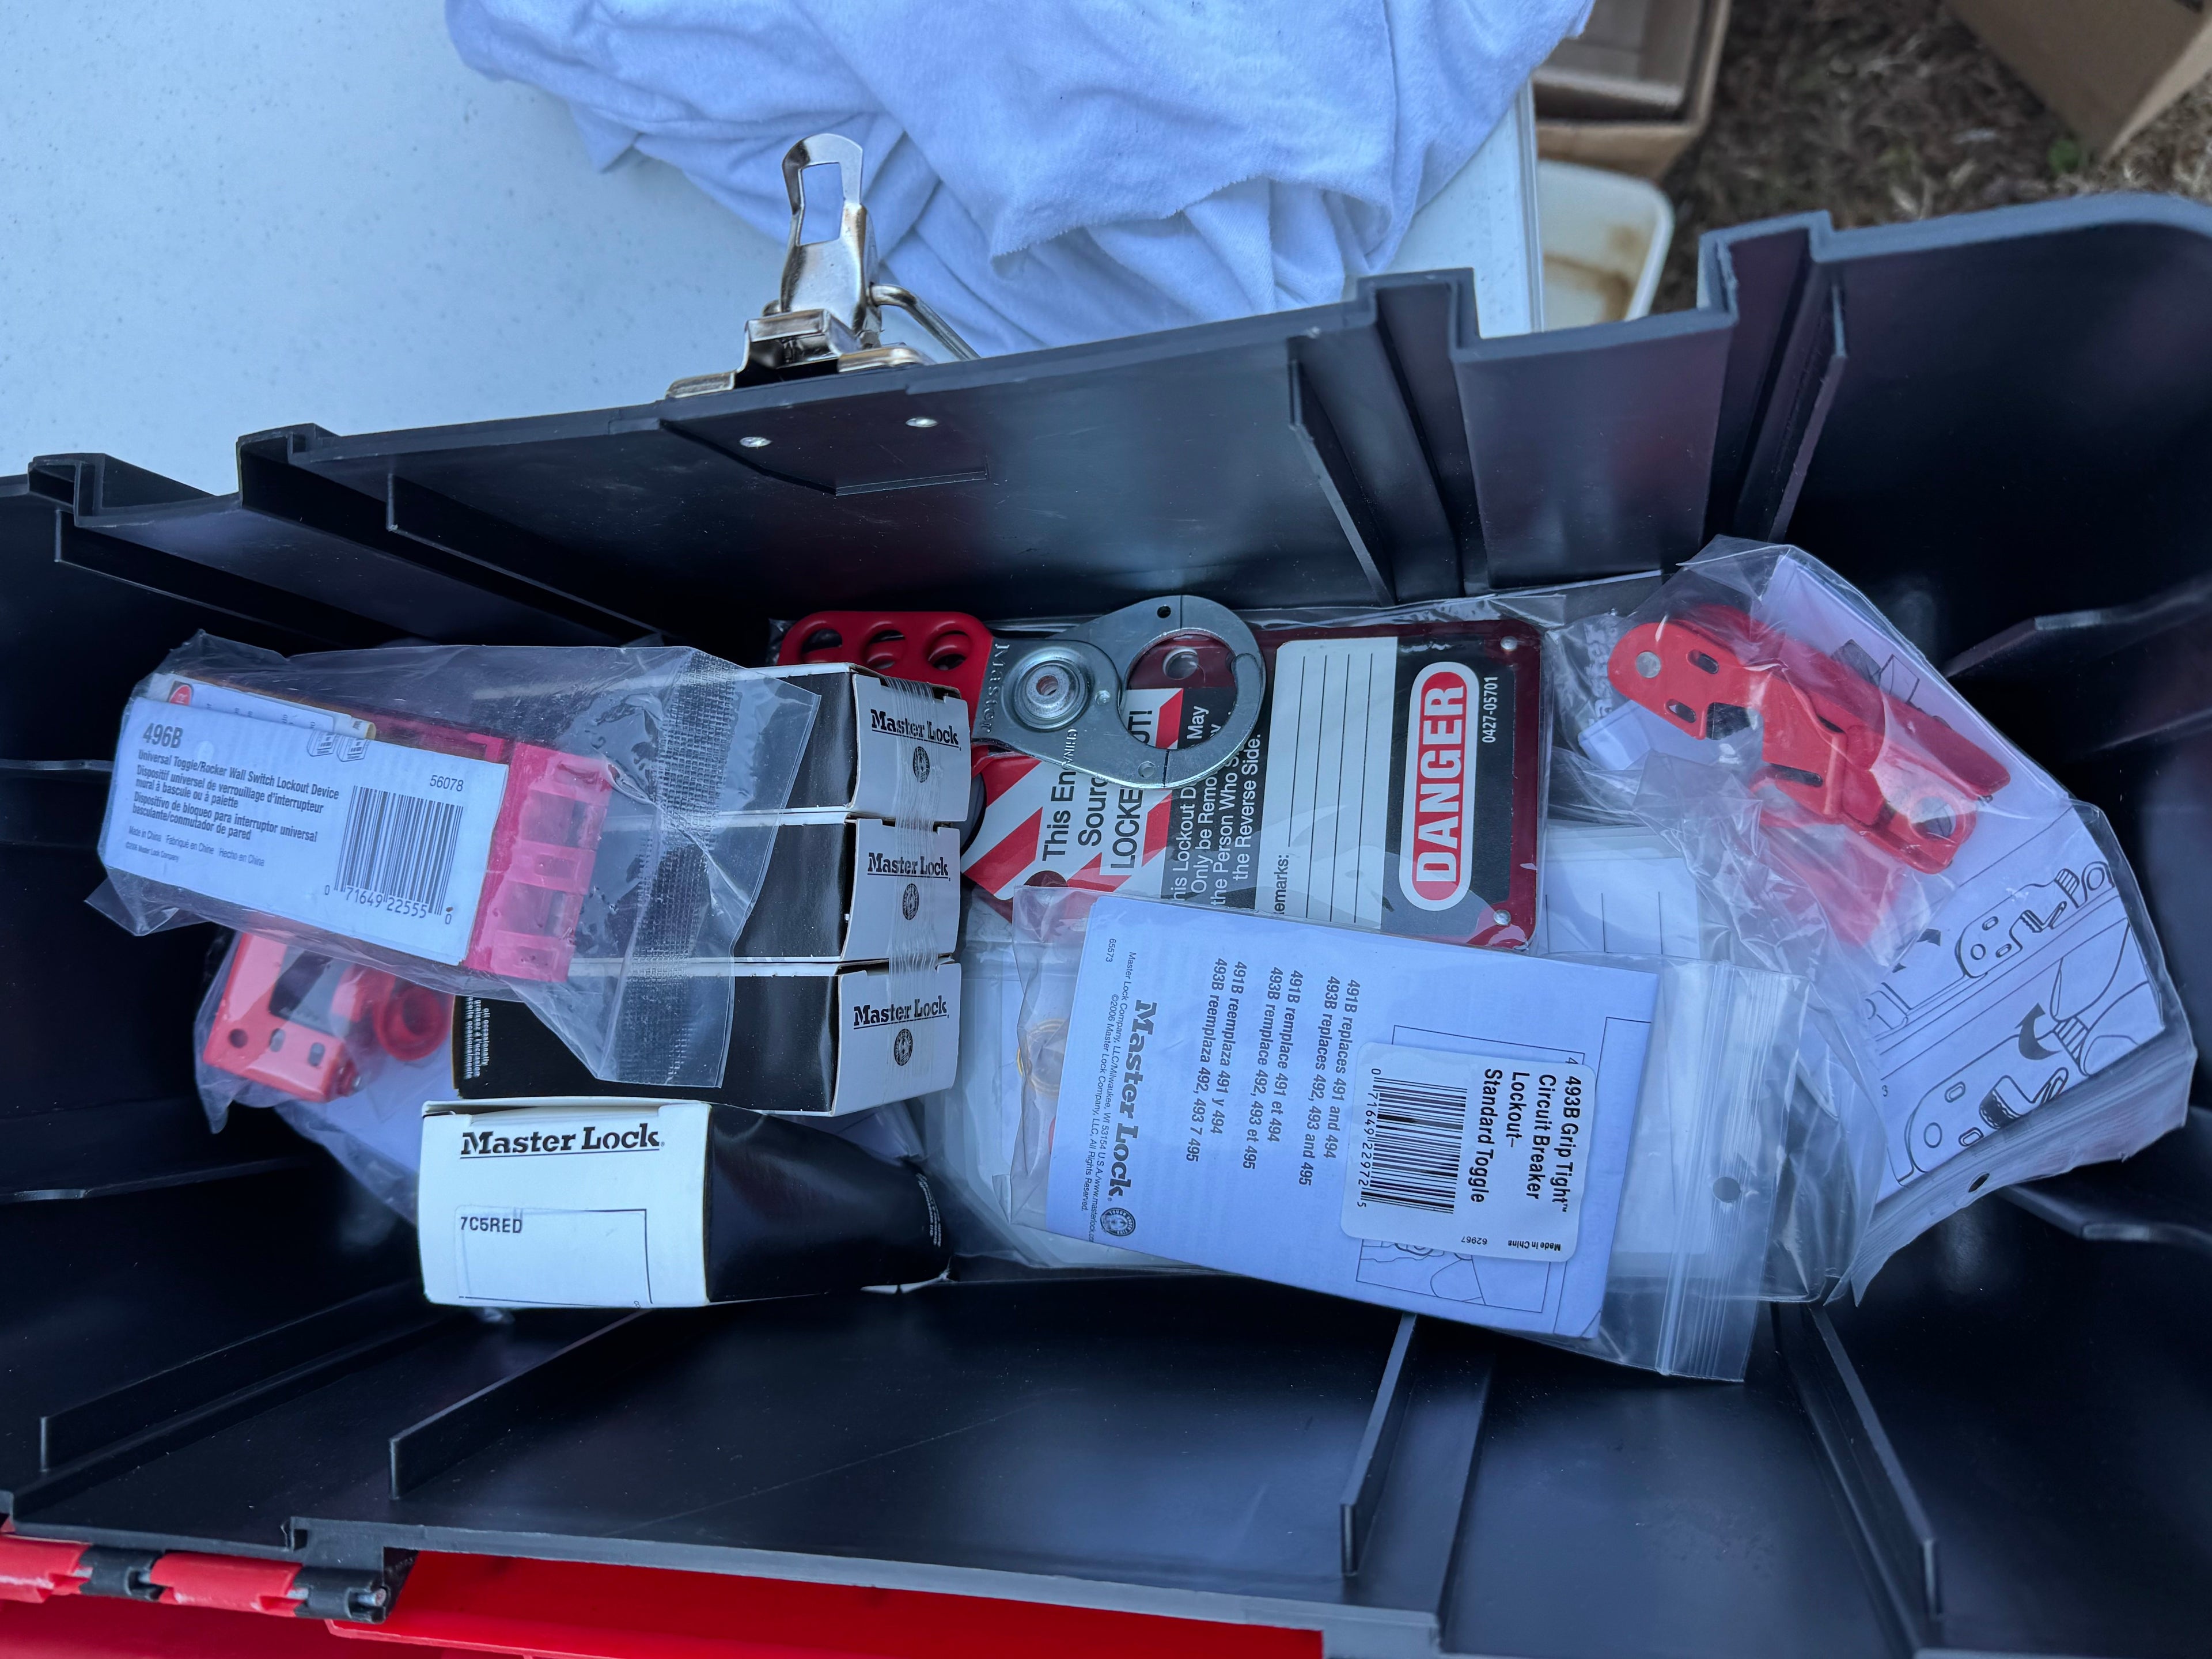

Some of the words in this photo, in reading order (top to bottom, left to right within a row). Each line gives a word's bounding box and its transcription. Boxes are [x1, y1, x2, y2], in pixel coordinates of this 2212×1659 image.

[980, 643, 1010, 733] Master
[1187, 706, 1209, 739] May
[1482, 676, 1498, 743] 0427-05701
[143, 723, 183, 749] 496B
[870, 709, 925, 738] Master
[926, 720, 959, 745] Lock
[1241, 734, 1261, 775] Side.
[138, 749, 171, 765] Universal
[174, 756, 228, 777] Toggle/Rocker
[229, 767, 246, 781] Wall
[248, 771, 275, 787] Switch
[276, 777, 309, 793] Lockout
[310, 783, 339, 800] Device
[172, 772, 205, 789] universel
[207, 779, 217, 791] de
[219, 783, 265, 803] verrouillage
[429, 775, 464, 792] 56078
[1416, 685, 1464, 882] DANGER
[135, 778, 154, 791] mural
[162, 783, 191, 800] bascule
[192, 790, 203, 801] ou
[211, 794, 238, 809] palette
[1219, 772, 1238, 810] Who
[134, 791, 169, 809] Dispositivo
[171, 799, 181, 811] de
[183, 802, 212, 819] bloqueo
[214, 812, 232, 824] para
[234, 813, 278, 833] interruptor
[280, 826, 318, 843] universal
[1077, 777, 1109, 847] Sourc
[1235, 780, 1256, 847] Reverse
[216, 823, 226, 835] de
[228, 827, 252, 840] pared
[1042, 810, 1071, 861] This
[1111, 786, 1143, 869] LOCKE
[1173, 804, 1195, 871] Lockout
[1195, 828, 1212, 850] be
[1213, 815, 1233, 873] Person
[868, 853, 918, 875] Master
[920, 856, 949, 876] Lock
[1191, 854, 1213, 893] Only
[1232, 853, 1250, 881] the
[1169, 877, 1187, 901] his
[1210, 878, 1228, 906] the
[1273, 855, 1289, 915] emarks:
[324, 885, 330, 895] 0
[346, 887, 383, 908] 71649
[387, 897, 427, 919] 22555
[445, 914, 452, 925] 0
[1105, 938, 1116, 963] 65573
[1125, 952, 1137, 979] Master
[1211, 958, 1228, 991] 493B
[1231, 961, 1247, 994] 491B
[1122, 981, 1132, 1001] Lock
[1267, 967, 1283, 1000] 493B
[1287, 970, 1304, 1003] 491B
[1324, 976, 1340, 1010] 493B
[1344, 979, 1361, 1013] 491B
[854, 1004, 911, 1027] Master
[914, 995, 947, 1018] Lock
[1104, 1023, 1115, 1052] Master
[1200, 994, 1219, 1063] reemplaza
[1219, 998, 1239, 1066] reemplaza
[1257, 1004, 1275, 1066] remplace
[1277, 1007, 1296, 1069] remplace
[1315, 1013, 1333, 1070] replaces
[1119, 999, 1157, 1119] Master
[1335, 1017, 1353, 1074] replaces
[1100, 1054, 1109, 1074] Lock
[1193, 1067, 1211, 1094] 492,
[1216, 1070, 1230, 1093] 491
[1250, 1069, 1268, 1096] 492,
[1273, 1073, 1289, 1096] 491
[1308, 1074, 1326, 1101] 492,
[1332, 1077, 1347, 1101] 491
[1882, 1085, 1888, 1097] 3
[1191, 1098, 1206, 1123] 493
[1212, 1097, 1225, 1107] y
[1271, 1101, 1283, 1115] et
[1477, 1069, 1503, 1145] Standard
[1534, 1074, 1556, 1131] Circuit
[1563, 1075, 1582, 1118] 493B
[1103, 1112, 1111, 1123] WI
[1210, 1109, 1225, 1134] 494
[1249, 1100, 1264, 1126] 493
[1307, 1105, 1321, 1130] 493
[1327, 1105, 1340, 1131] and
[1364, 1092, 1378, 1135] 71649
[461, 1130, 576, 1155] Master
[1089, 1138, 1097, 1149] All
[1099, 1124, 1109, 1150] 53154
[1190, 1127, 1203, 1135] 7
[1247, 1128, 1259, 1143] et
[1267, 1118, 1282, 1142] 494
[1554, 1123, 1579, 1157] Grip
[1186, 1138, 1200, 1162] 495
[1243, 1145, 1257, 1169] 495
[1302, 1134, 1316, 1158] and
[1323, 1134, 1339, 1158] 494
[1085, 1151, 1096, 1176] Rights
[1298, 1162, 1313, 1186] 495
[1358, 1142, 1373, 1186] 22972
[1468, 1149, 1494, 1203] Toggle
[1526, 1135, 1550, 1199] Breaker
[460, 1215, 522, 1234] 7C5RED
[1461, 1236, 1487, 1245] 62967
[1508, 1240, 1529, 1249] China
[1540, 1242, 1561, 1251] Made
